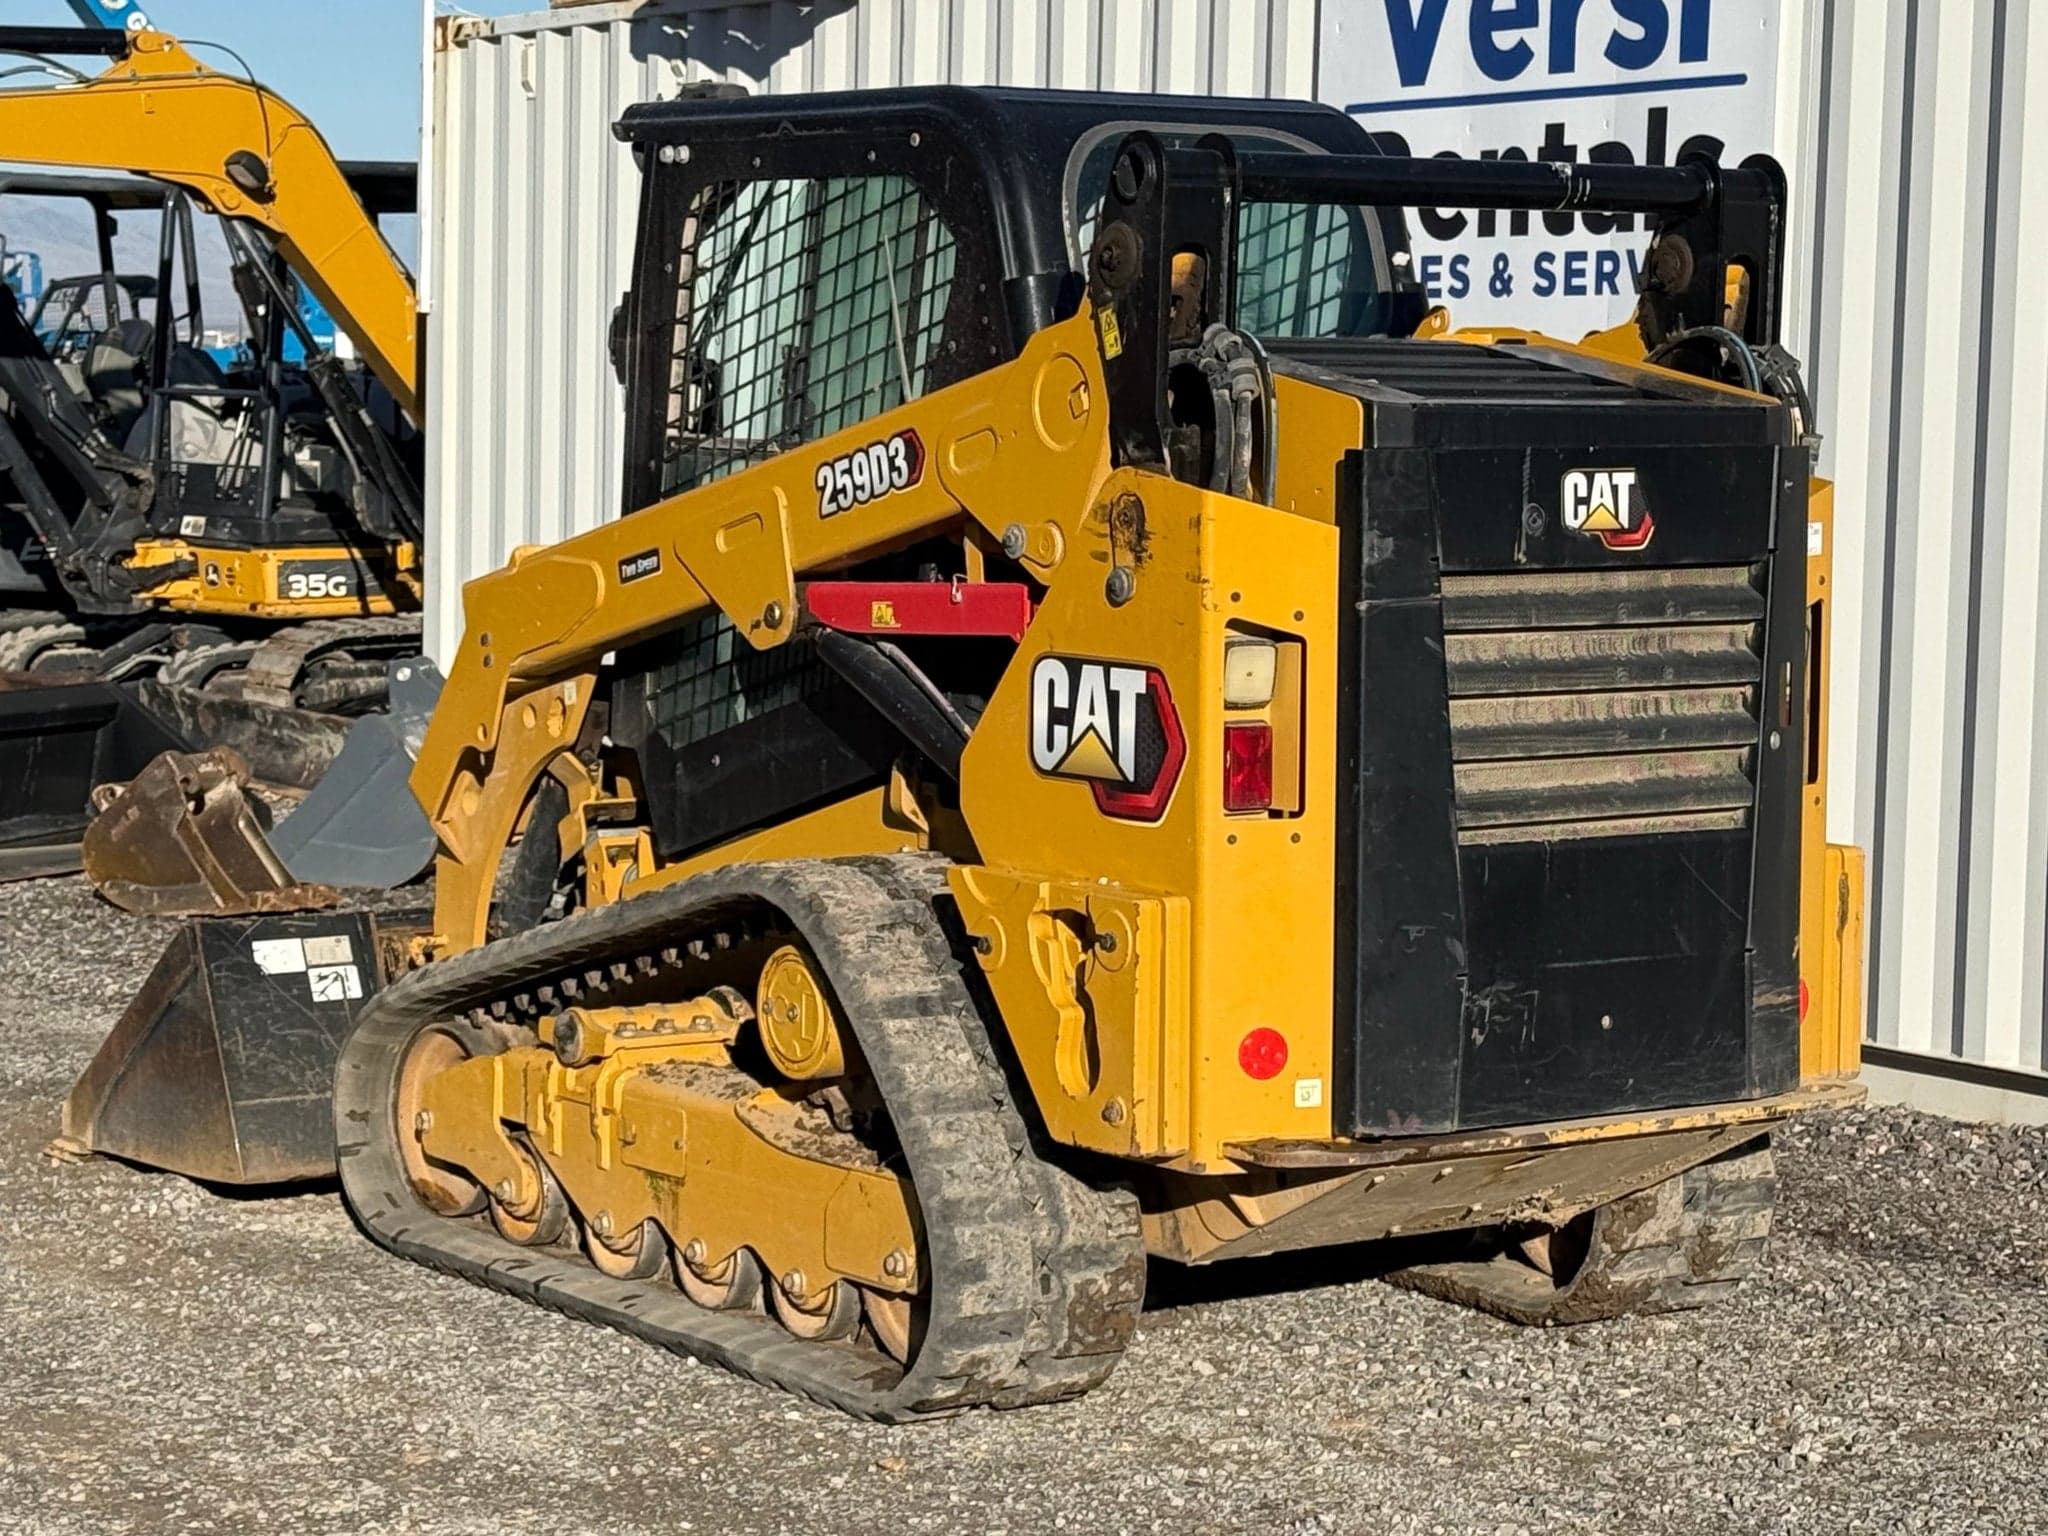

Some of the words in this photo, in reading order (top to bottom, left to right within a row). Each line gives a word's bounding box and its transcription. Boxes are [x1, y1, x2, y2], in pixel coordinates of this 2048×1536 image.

[1489, 252, 1513, 298] &
[817, 436, 909, 517] 259D3
[1563, 471, 1635, 530] CAT
[287, 573, 347, 598] 35G
[1033, 657, 1148, 783] CAT
